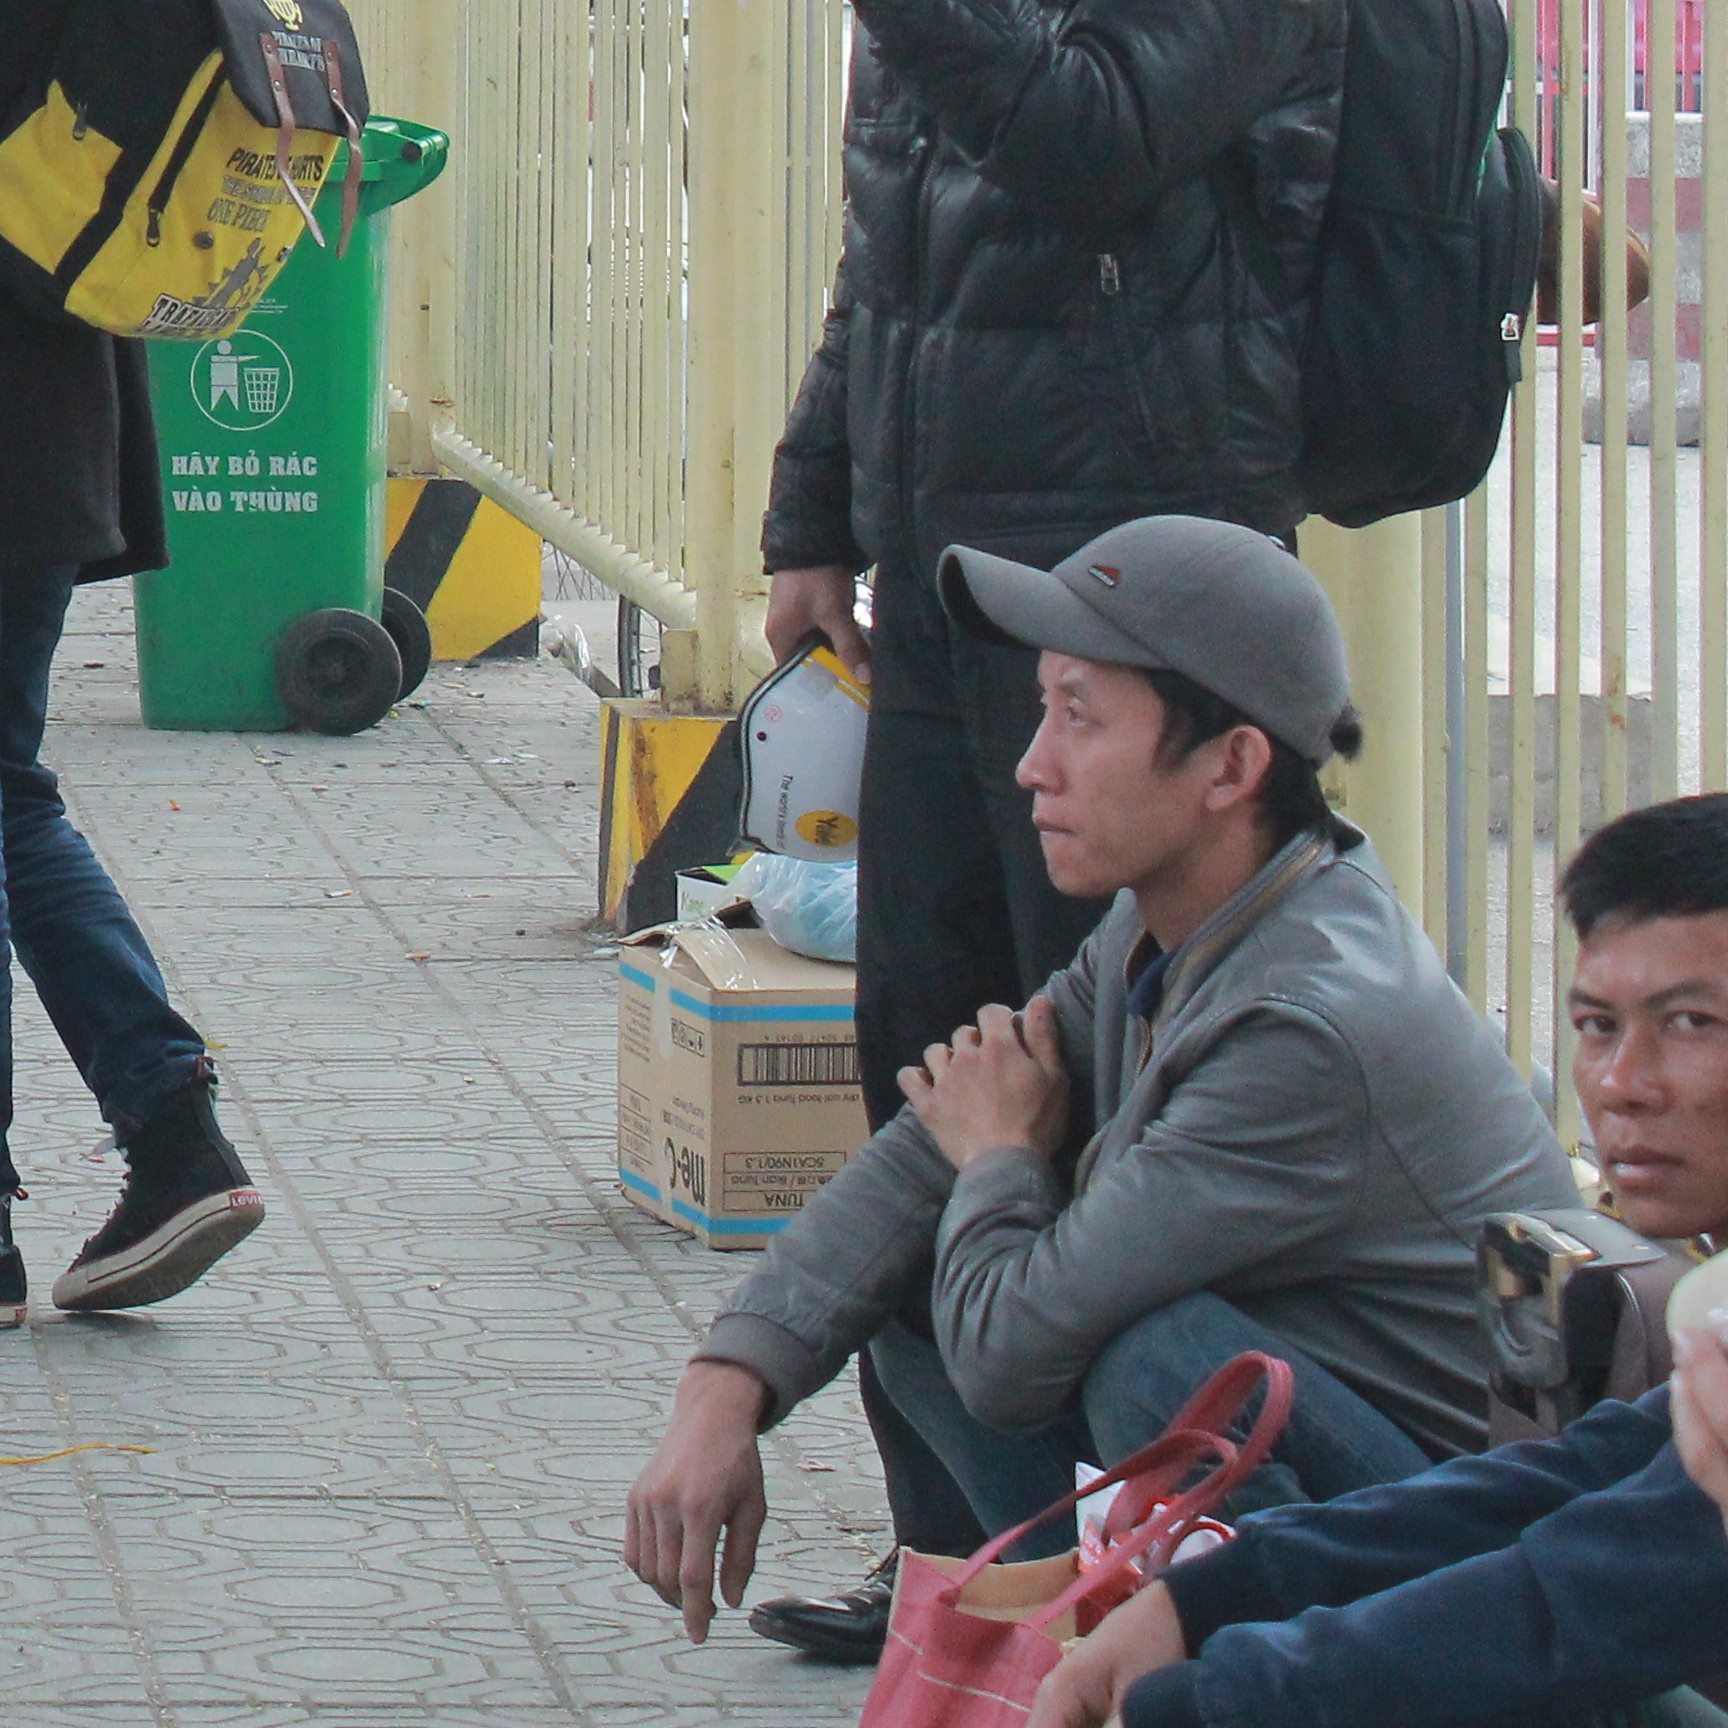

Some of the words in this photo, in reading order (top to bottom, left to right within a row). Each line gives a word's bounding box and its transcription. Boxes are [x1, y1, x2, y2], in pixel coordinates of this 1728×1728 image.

[227, 449, 260, 476] BỎ
[268, 451, 318, 476] RÁC
[171, 485, 222, 512] VÀO
[230, 485, 318, 512] THÙNG
[764, 1193, 805, 1208] TUNA
